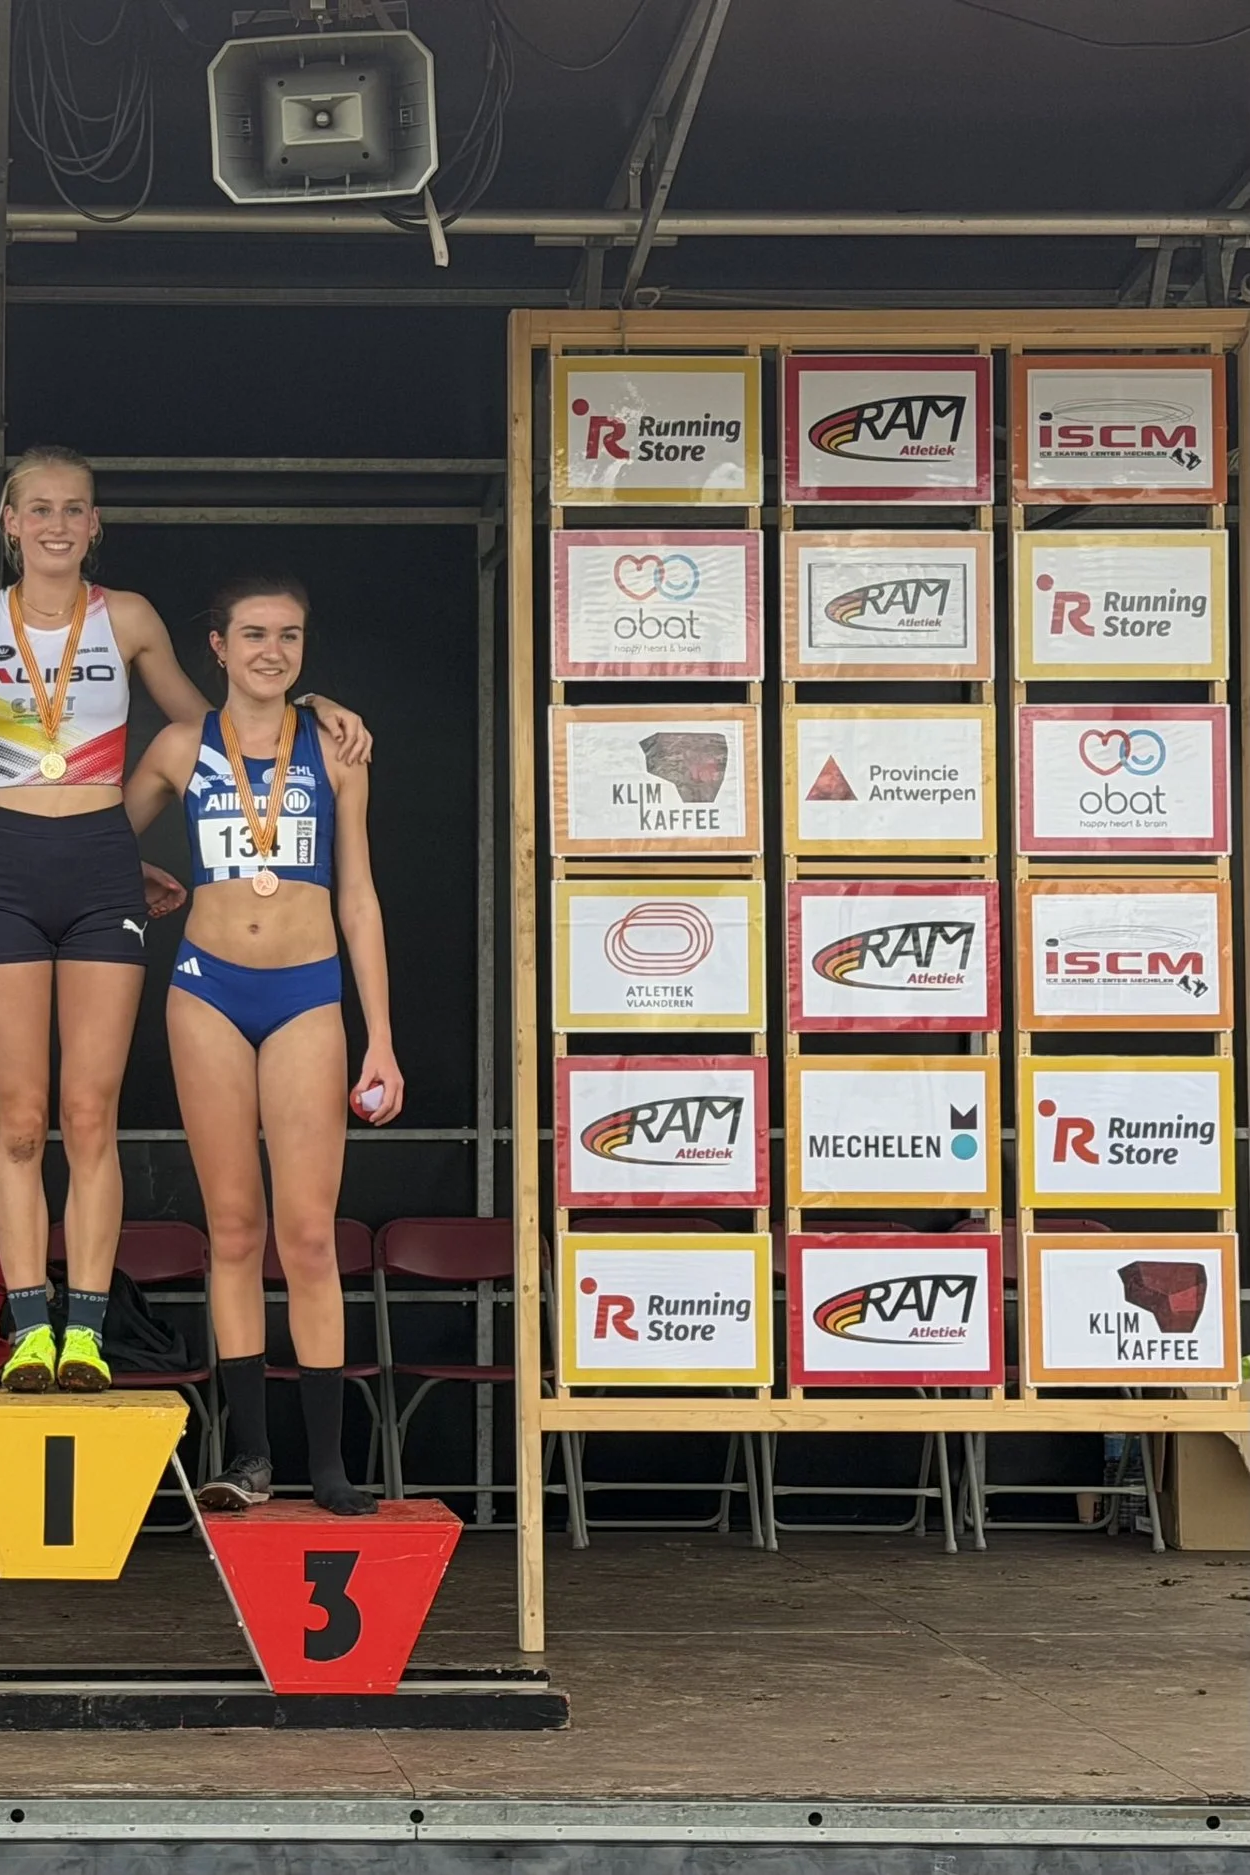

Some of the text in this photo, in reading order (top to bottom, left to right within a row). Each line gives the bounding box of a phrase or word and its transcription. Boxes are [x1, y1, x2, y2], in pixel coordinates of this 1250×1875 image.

[638, 413, 741, 442] Running
[852, 395, 966, 442] RAM
[638, 441, 705, 462] Store
[900, 445, 956, 456] Atletiek
[861, 578, 951, 616] RAM
[1104, 588, 1207, 617] Running
[614, 608, 700, 639] obat
[898, 618, 942, 627] Atletiek
[1103, 616, 1171, 637] Store
[286, 766, 314, 777] CHL
[869, 765, 958, 781] Provincie
[205, 792, 270, 812] Allin
[613, 783, 662, 810] KLIM
[869, 785, 976, 804] Antwerpen
[1080, 783, 1166, 814] obat
[640, 809, 720, 830] KAFFEE
[1080, 820, 1107, 829] happy
[858, 921, 975, 969] RAM
[907, 973, 965, 984] Atletiek
[626, 986, 694, 997] ATLETIEK
[626, 1096, 744, 1144] RAM
[1108, 1114, 1215, 1145] Running
[675, 1148, 733, 1159] Atletiek
[809, 1135, 941, 1158] MECHELEN
[1108, 1143, 1178, 1164] Store
[648, 1292, 751, 1321] Running
[860, 1275, 977, 1323] RAM
[647, 1320, 715, 1341] Store
[909, 1327, 966, 1338] Atletiek
[1090, 1312, 1139, 1339] KLIM
[1117, 1340, 1198, 1360] KAFFEE
[303, 1550, 361, 1662] 3
